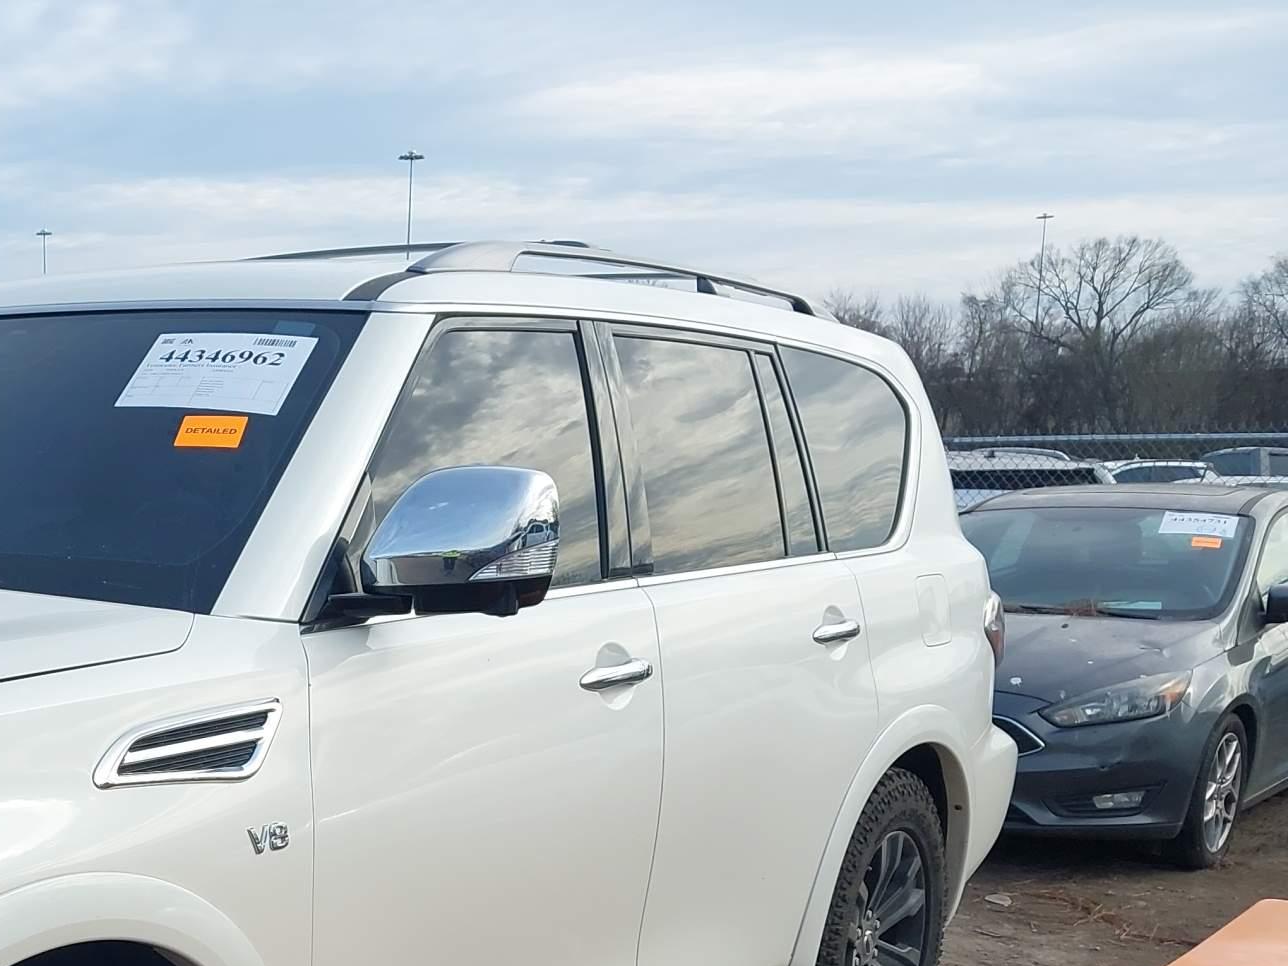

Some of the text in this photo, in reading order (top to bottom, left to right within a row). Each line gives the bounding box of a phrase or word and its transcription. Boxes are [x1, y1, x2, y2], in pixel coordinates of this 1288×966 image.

[159, 348, 286, 366] 44346962
[184, 427, 238, 435] DETAILED
[246, 822, 289, 855] V8
